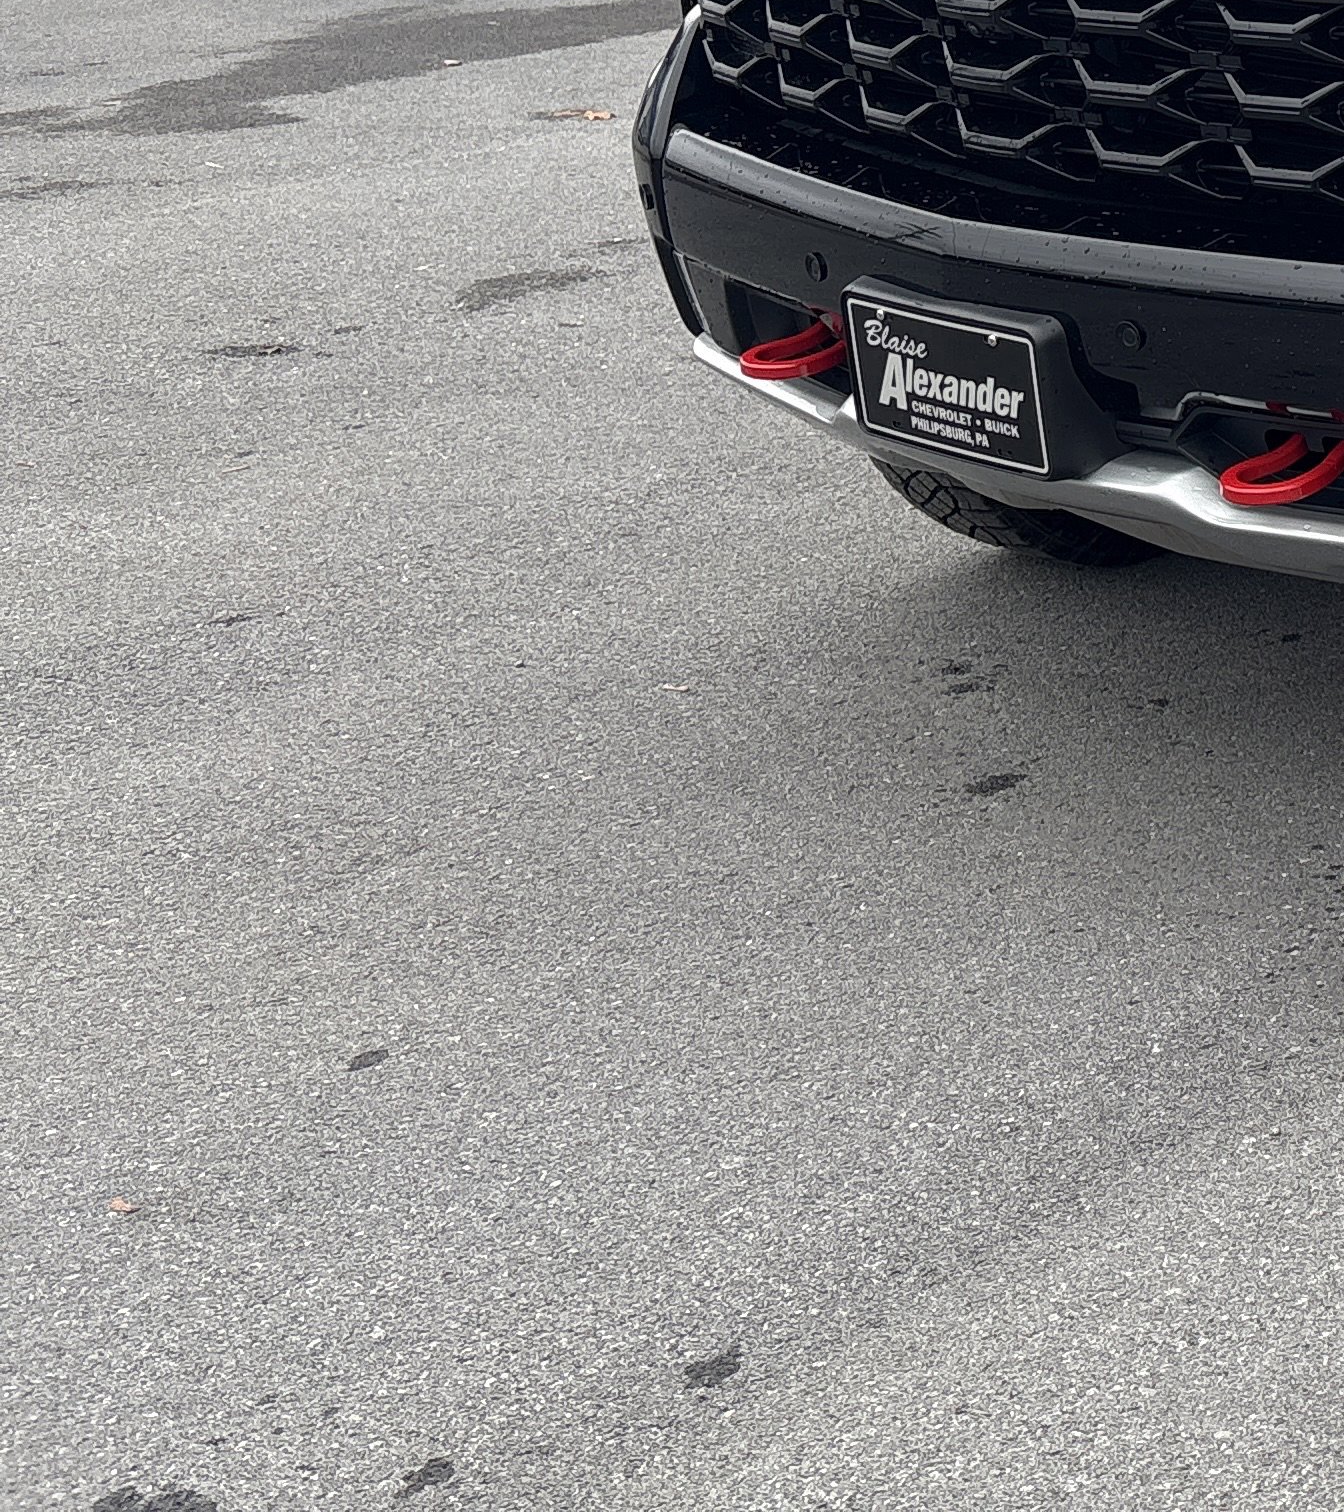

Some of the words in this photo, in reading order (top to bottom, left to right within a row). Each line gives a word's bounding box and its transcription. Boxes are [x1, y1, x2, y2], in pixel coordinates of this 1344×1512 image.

[863, 318, 928, 359] Blaise
[878, 352, 1024, 419] Alexander
[910, 416, 975, 447] PHILIPSBURG,
[975, 432, 990, 448] PA
[911, 400, 973, 427] CHEVROLET
[984, 418, 1020, 439] BUICK
